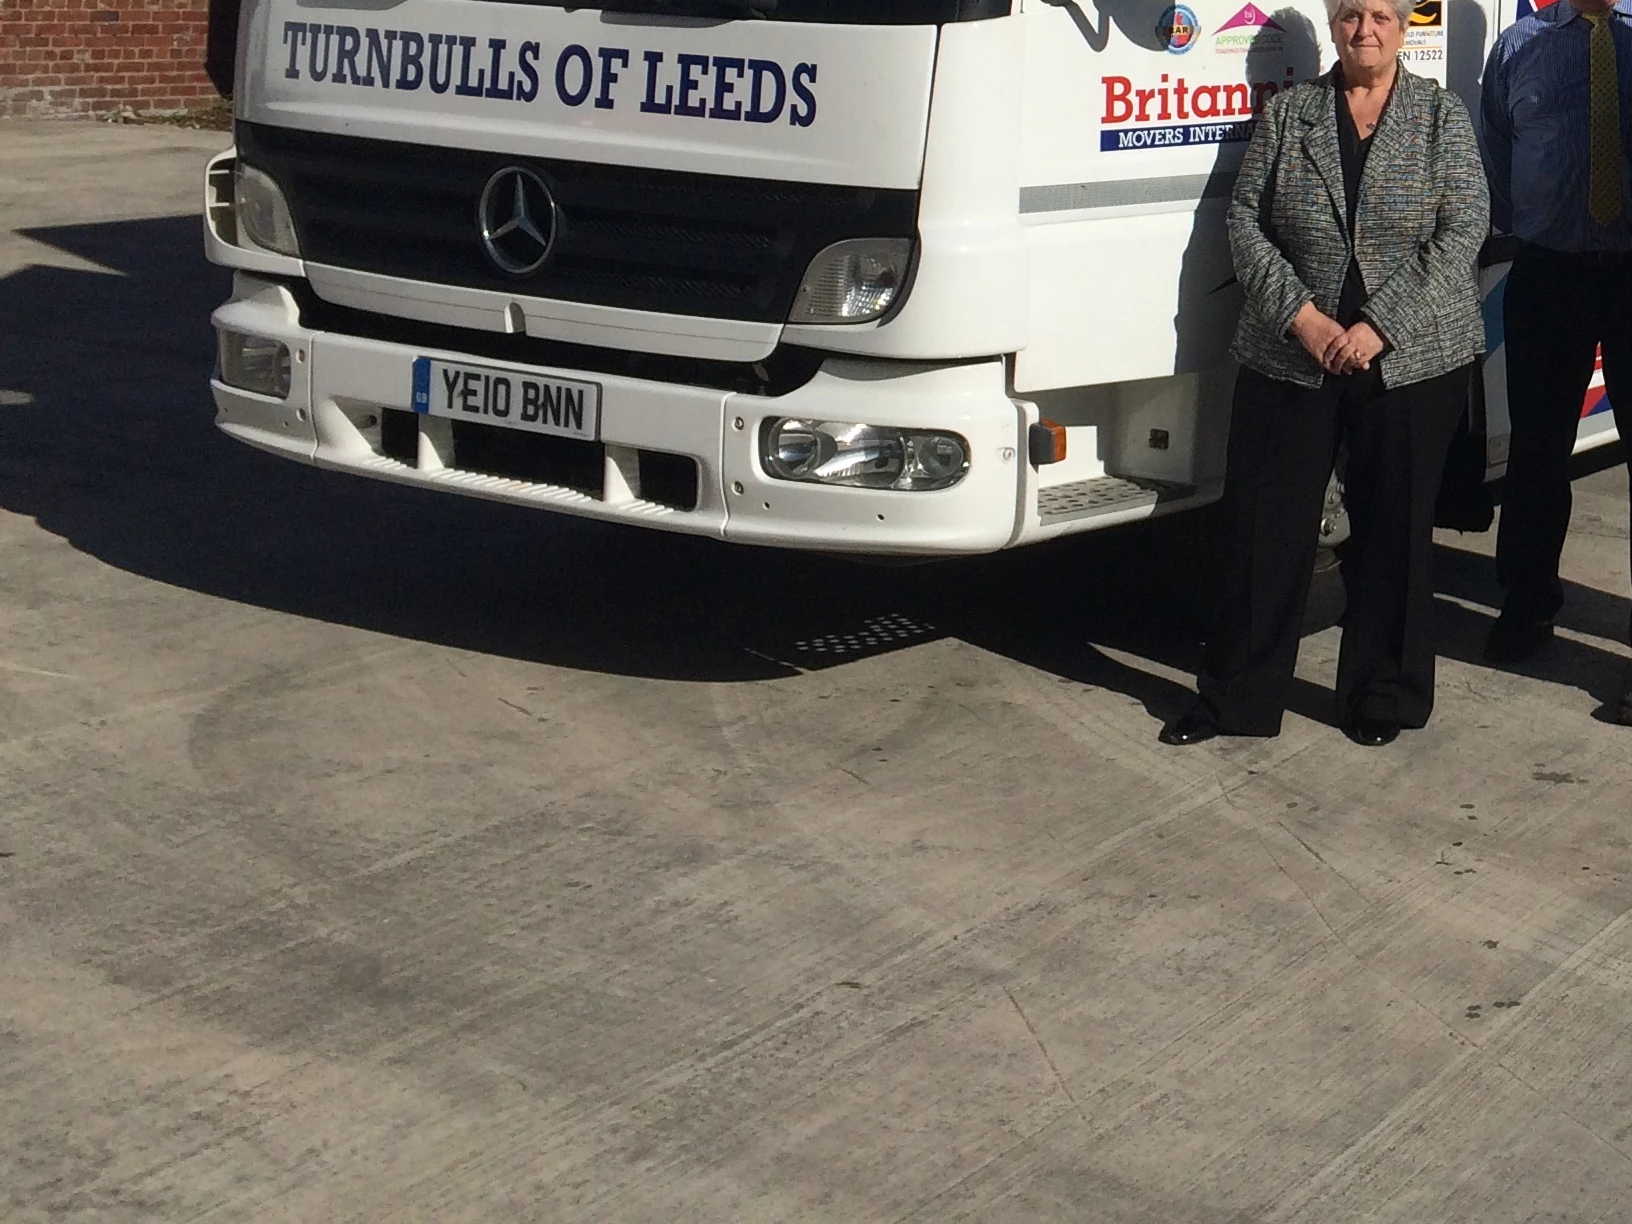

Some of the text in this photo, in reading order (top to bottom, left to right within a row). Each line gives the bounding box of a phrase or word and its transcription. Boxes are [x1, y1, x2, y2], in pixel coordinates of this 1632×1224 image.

[283, 21, 818, 128] TURNBULLS OF LEEDS
[1414, 49, 1443, 61] 12522
[1101, 66, 1296, 124] Britann
[1118, 123, 1254, 148] MOVERS INTERNA
[442, 368, 584, 430] YE10 BNN
